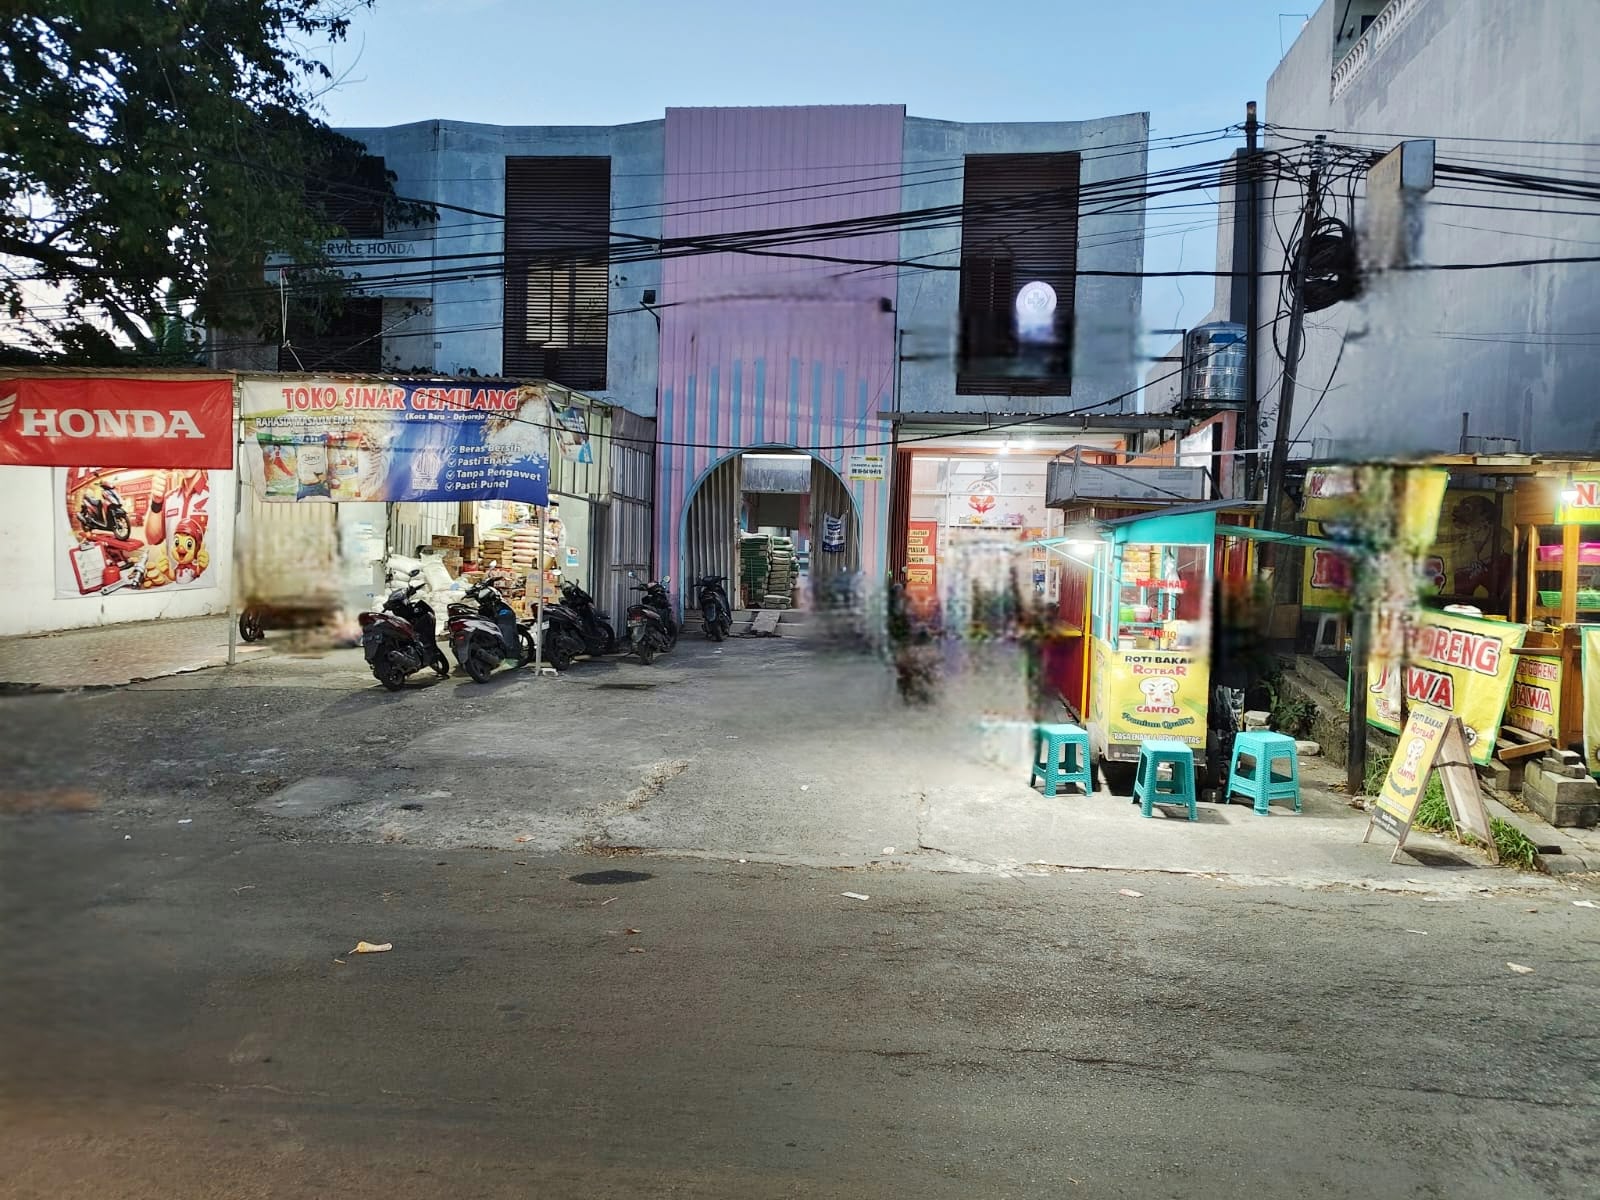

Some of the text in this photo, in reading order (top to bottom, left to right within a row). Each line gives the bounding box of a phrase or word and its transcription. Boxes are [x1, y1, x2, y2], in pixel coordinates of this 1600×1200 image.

[367, 243, 416, 254] HONDA
[282, 387, 519, 411] TOKO SINAR GEMILANG
[19, 408, 205, 439] HONDA
[256, 417, 292, 427] RAHASIA
[460, 443, 521, 454] Beras Bersih
[458, 456, 510, 466] Pasti Enak
[457, 469, 541, 482] Tanpa Pengawet
[455, 480, 509, 490] Pasti Punel
[1420, 627, 1500, 675] ORENG
[1528, 660, 1558, 682] GORENG
[1371, 665, 1453, 709] JWA
[1511, 683, 1553, 715] JAWA
[1136, 706, 1180, 714] CANTIQ
[1122, 712, 1194, 729] Premium Quality
